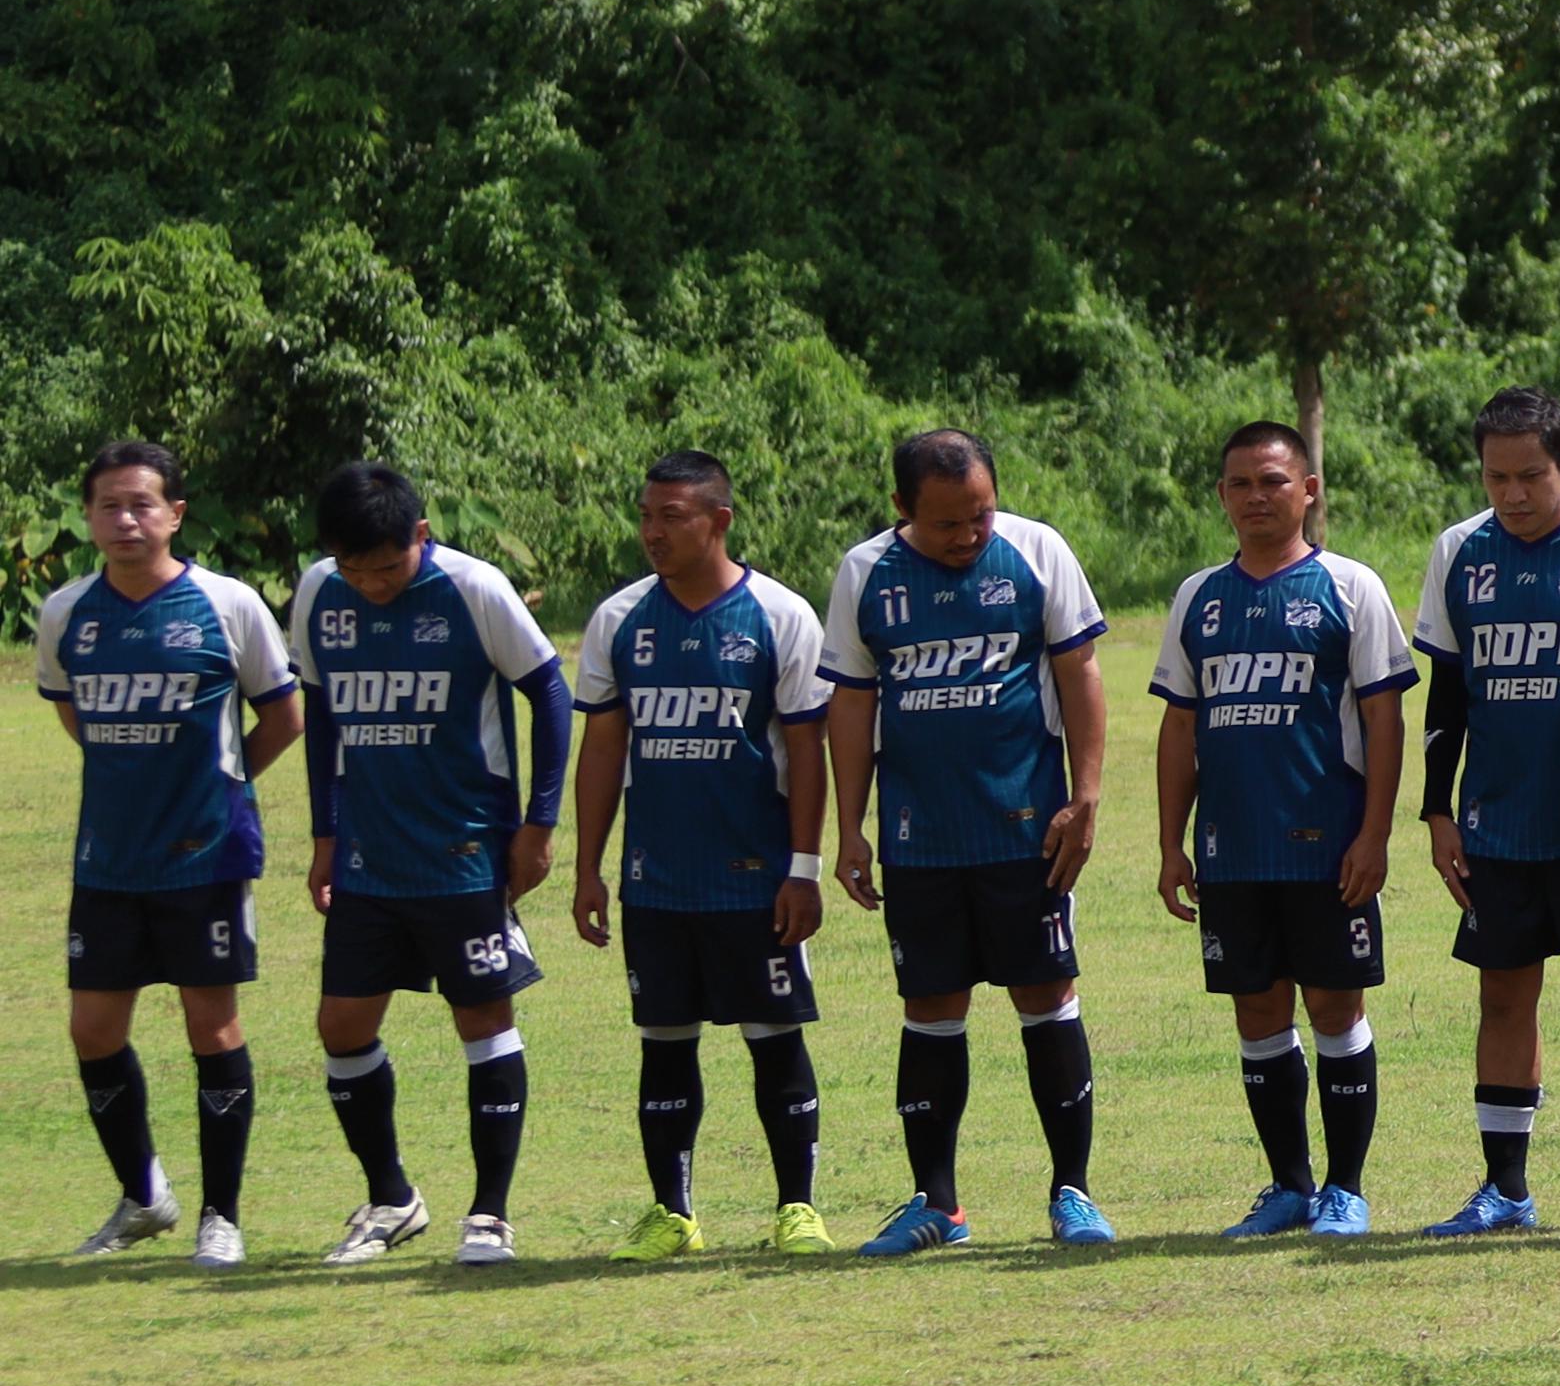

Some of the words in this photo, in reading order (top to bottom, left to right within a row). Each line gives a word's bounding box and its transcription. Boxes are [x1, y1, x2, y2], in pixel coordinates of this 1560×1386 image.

[1463, 563, 1498, 605] 12
[878, 585, 911, 627] 11
[1201, 599, 1222, 637] 3
[76, 620, 100, 656] 9
[633, 628, 655, 667] 5
[889, 632, 1020, 681] DOPA
[72, 671, 200, 713] DOPA
[327, 671, 451, 713] DOPA
[1201, 653, 1315, 698] DOPA
[630, 687, 752, 729] DOPA
[900, 682, 1004, 711] MAESOT
[83, 723, 181, 745] MAESOT
[340, 724, 436, 746] MAESOT
[1208, 703, 1300, 729] MAESOT
[211, 921, 230, 959] 9
[1349, 917, 1371, 959] 3
[768, 957, 792, 997] 5
[645, 1098, 687, 1109] EGO
[789, 1097, 817, 1114] EGO
[1331, 1083, 1367, 1094] EGO
